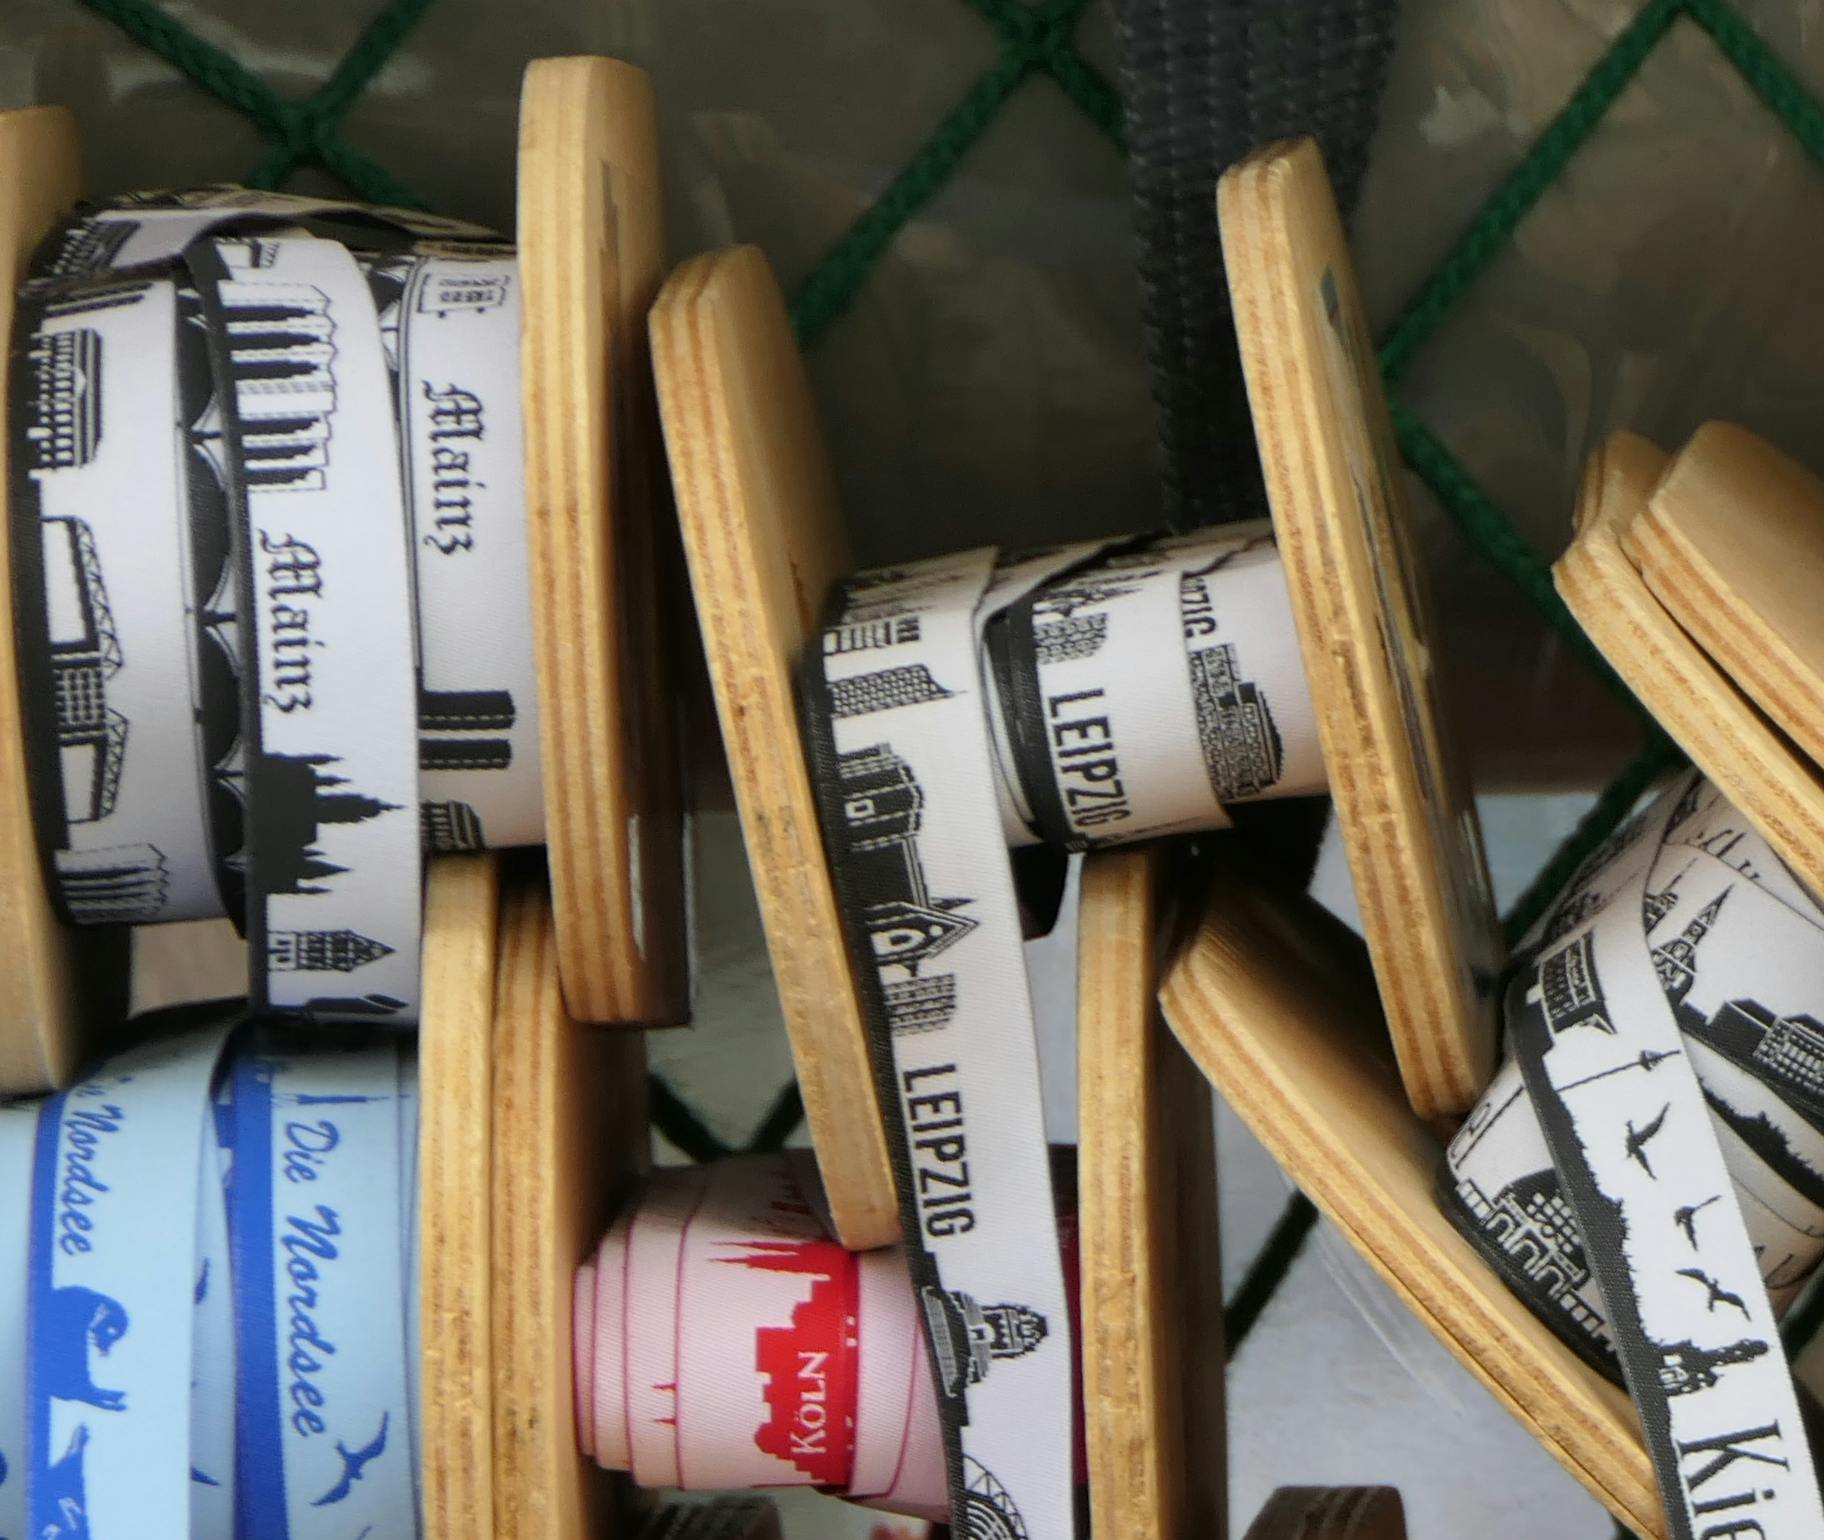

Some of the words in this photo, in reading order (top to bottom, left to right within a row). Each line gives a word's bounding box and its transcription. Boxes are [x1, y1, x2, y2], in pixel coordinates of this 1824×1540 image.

[420, 381, 487, 556] Mainz
[255, 529, 326, 716] Mainz
[1049, 688, 1131, 828] LEIPZIG
[59, 1103, 126, 1257] Nordsee
[281, 1120, 341, 1184] Die
[904, 1063, 975, 1239] LEIPZIG
[279, 1204, 345, 1438] Nordsee
[792, 1350, 831, 1456] KÖLN
